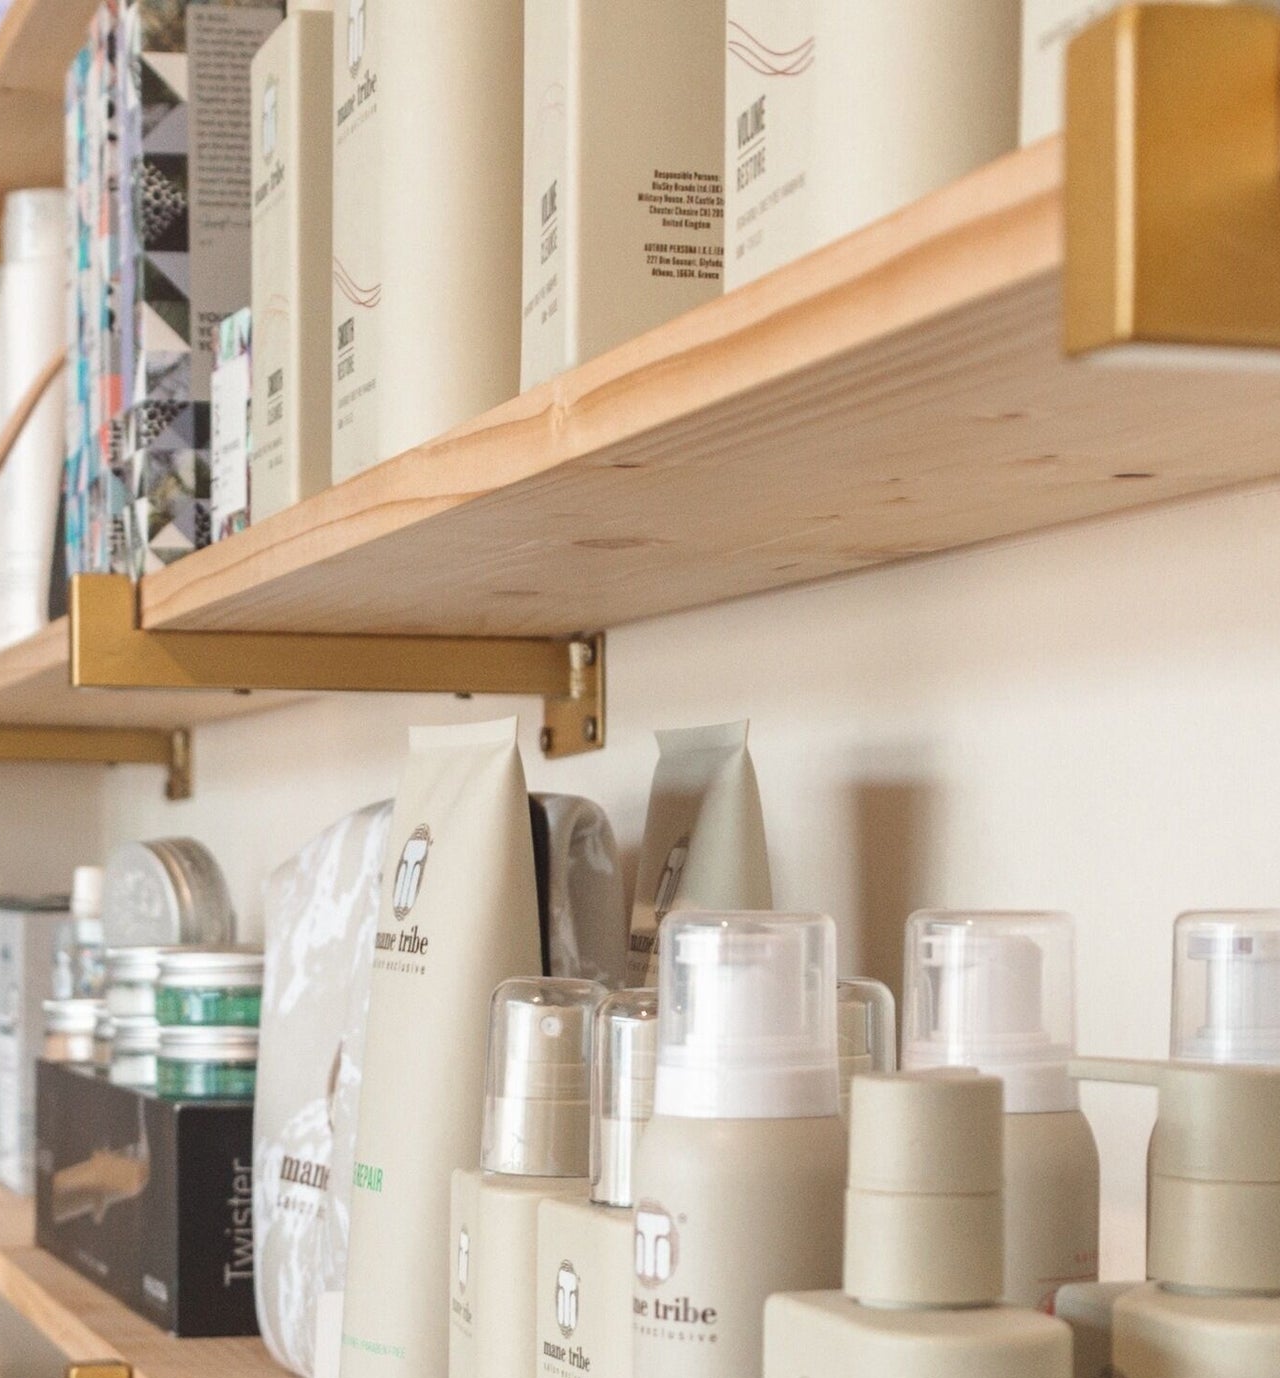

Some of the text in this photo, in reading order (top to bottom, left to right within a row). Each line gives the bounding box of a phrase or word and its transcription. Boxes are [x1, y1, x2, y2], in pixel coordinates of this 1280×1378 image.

[356, 68, 377, 106] tribe
[654, 169, 693, 181] Responsible
[674, 182, 696, 192] Brands
[662, 218, 711, 230] United Kingdom
[644, 243, 668, 252] AUTHOR
[669, 244, 697, 254] PERSONA
[398, 925, 429, 955] tribe
[223, 1157, 254, 1288] Twister
[654, 1297, 717, 1325] tribe
[543, 1340, 591, 1372] mane tribe
